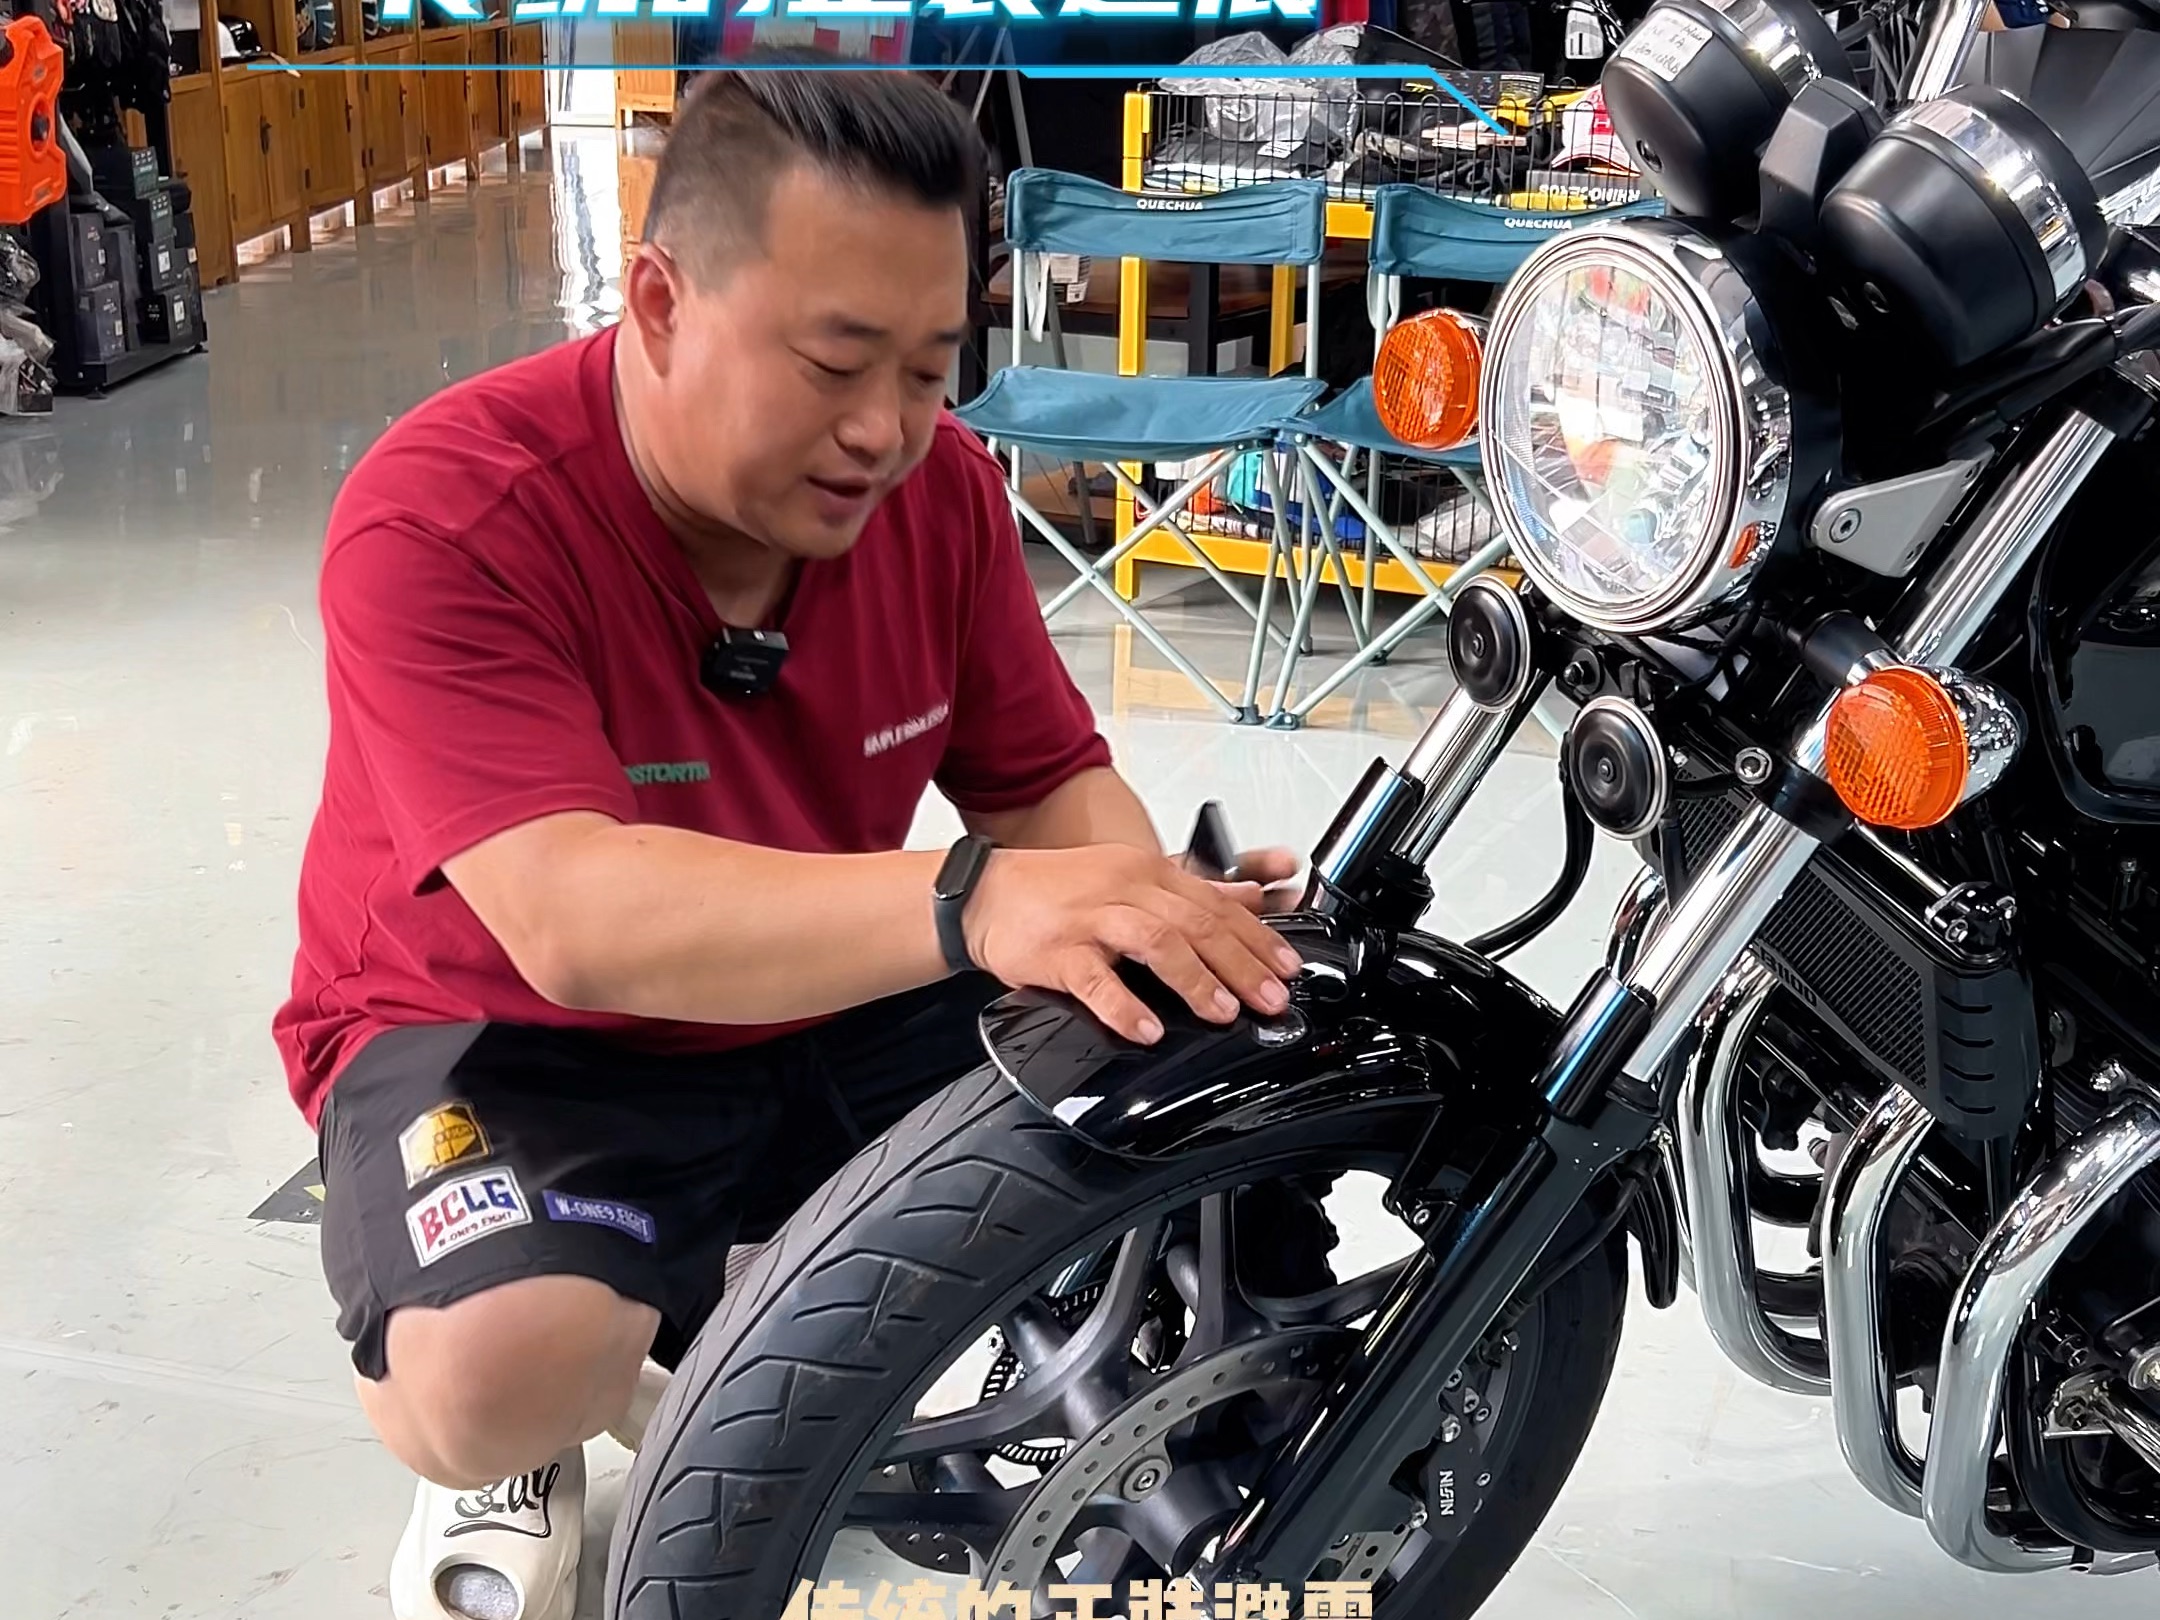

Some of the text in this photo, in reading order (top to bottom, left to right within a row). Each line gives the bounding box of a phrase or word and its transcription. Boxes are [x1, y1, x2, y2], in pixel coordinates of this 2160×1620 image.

[1136, 198, 1204, 211] QUECHUA
[1504, 217, 1573, 230] QUECHUA
[417, 1179, 518, 1251] BCLG
